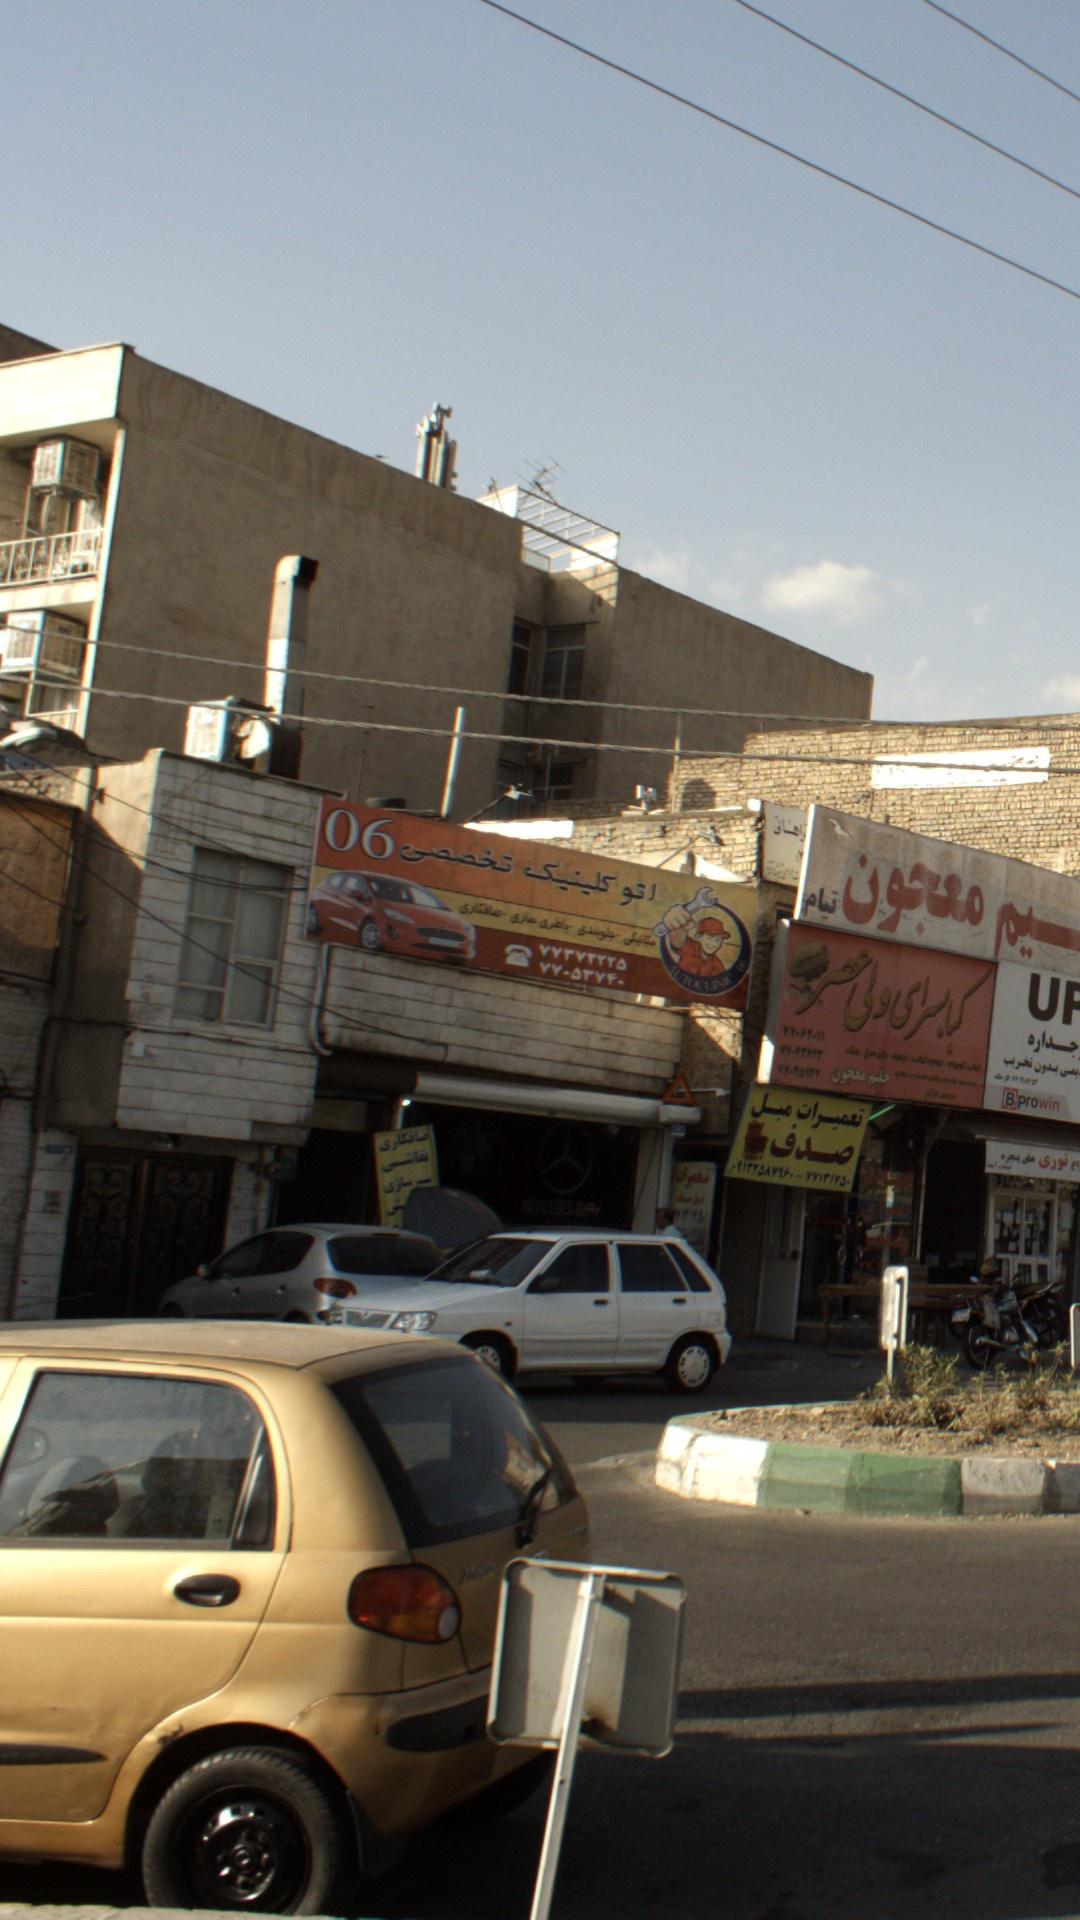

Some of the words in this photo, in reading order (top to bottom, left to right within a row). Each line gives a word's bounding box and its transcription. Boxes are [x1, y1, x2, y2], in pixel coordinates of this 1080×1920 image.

[325, 808, 396, 860] 06
[401, 845, 513, 873] تخصصی
[524, 863, 618, 895] کلینیک
[619, 882, 657, 906] اتو
[842, 853, 984, 935] معجون
[751, 1092, 793, 1121] مبل
[796, 1101, 866, 1130] تعمیرات
[770, 1123, 855, 1165] صدف
[1038, 1152, 1069, 1171] توری
